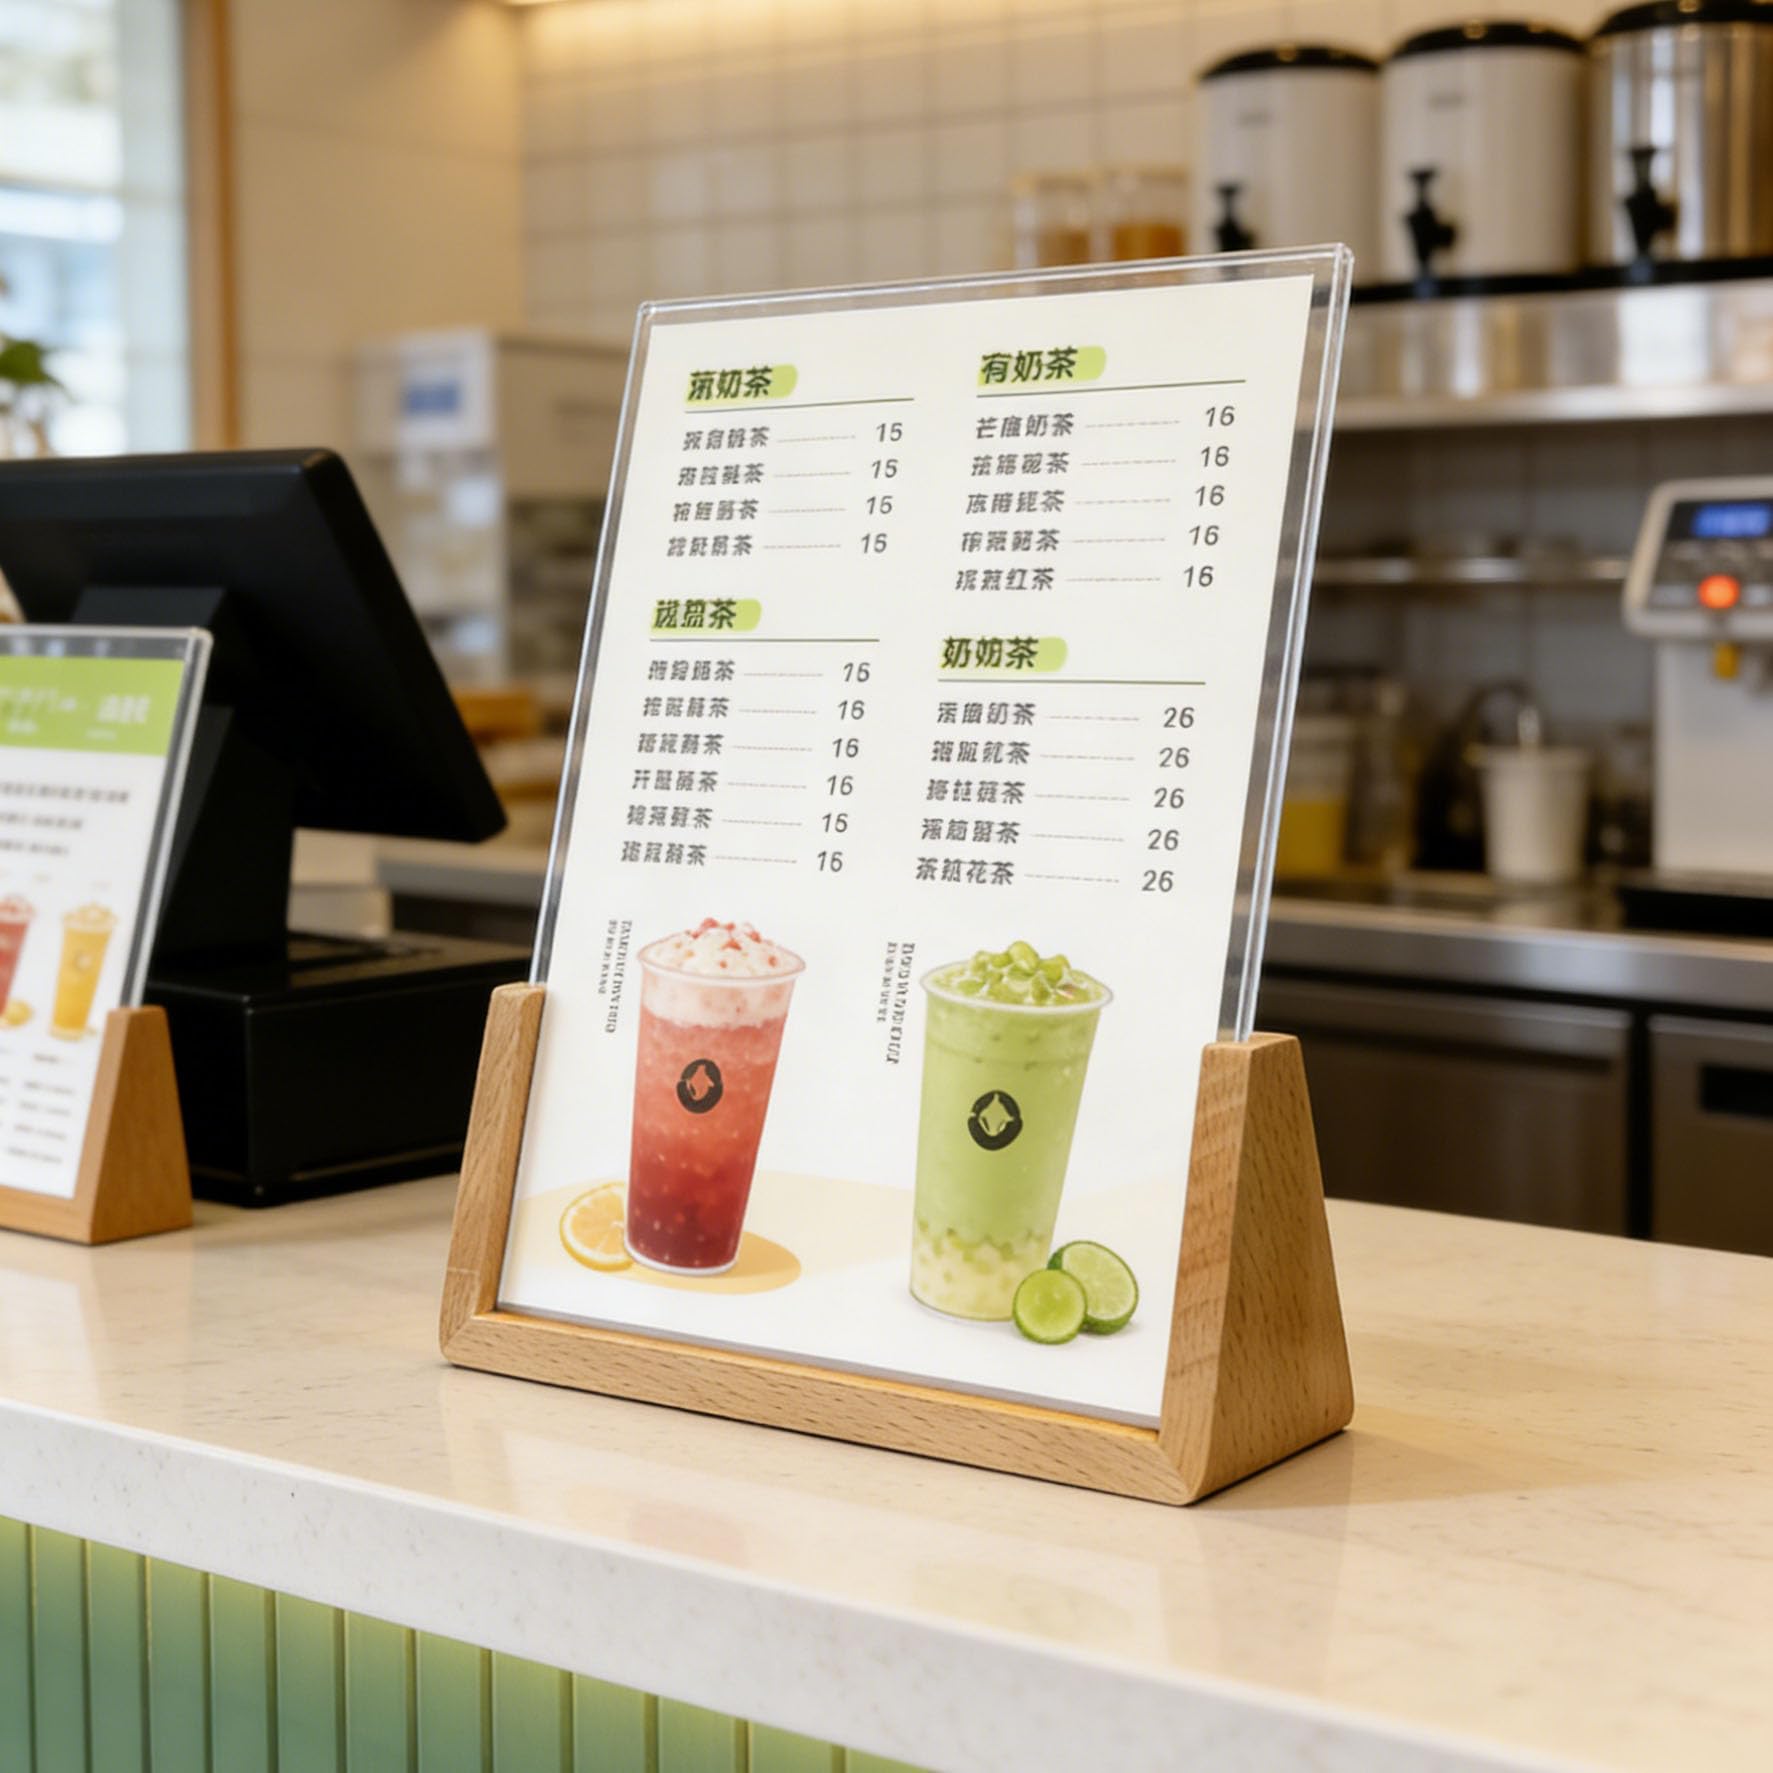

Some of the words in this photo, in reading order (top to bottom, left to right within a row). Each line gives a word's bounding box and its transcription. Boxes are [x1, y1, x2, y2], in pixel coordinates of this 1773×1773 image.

[1205, 405, 1235, 428] 16
[876, 422, 903, 442] 15
[1201, 445, 1230, 468] 16
[1195, 484, 1225, 507] 16
[1189, 524, 1220, 546] 16
[1184, 565, 1214, 588] 16
[838, 699, 865, 721] 16
[1163, 706, 1195, 729] 26
[832, 737, 859, 759] 16
[1159, 746, 1190, 769] 26
[827, 774, 853, 796] 16
[1154, 787, 1185, 809] 26
[1147, 828, 1179, 851] 26
[1141, 869, 1174, 893] 26
